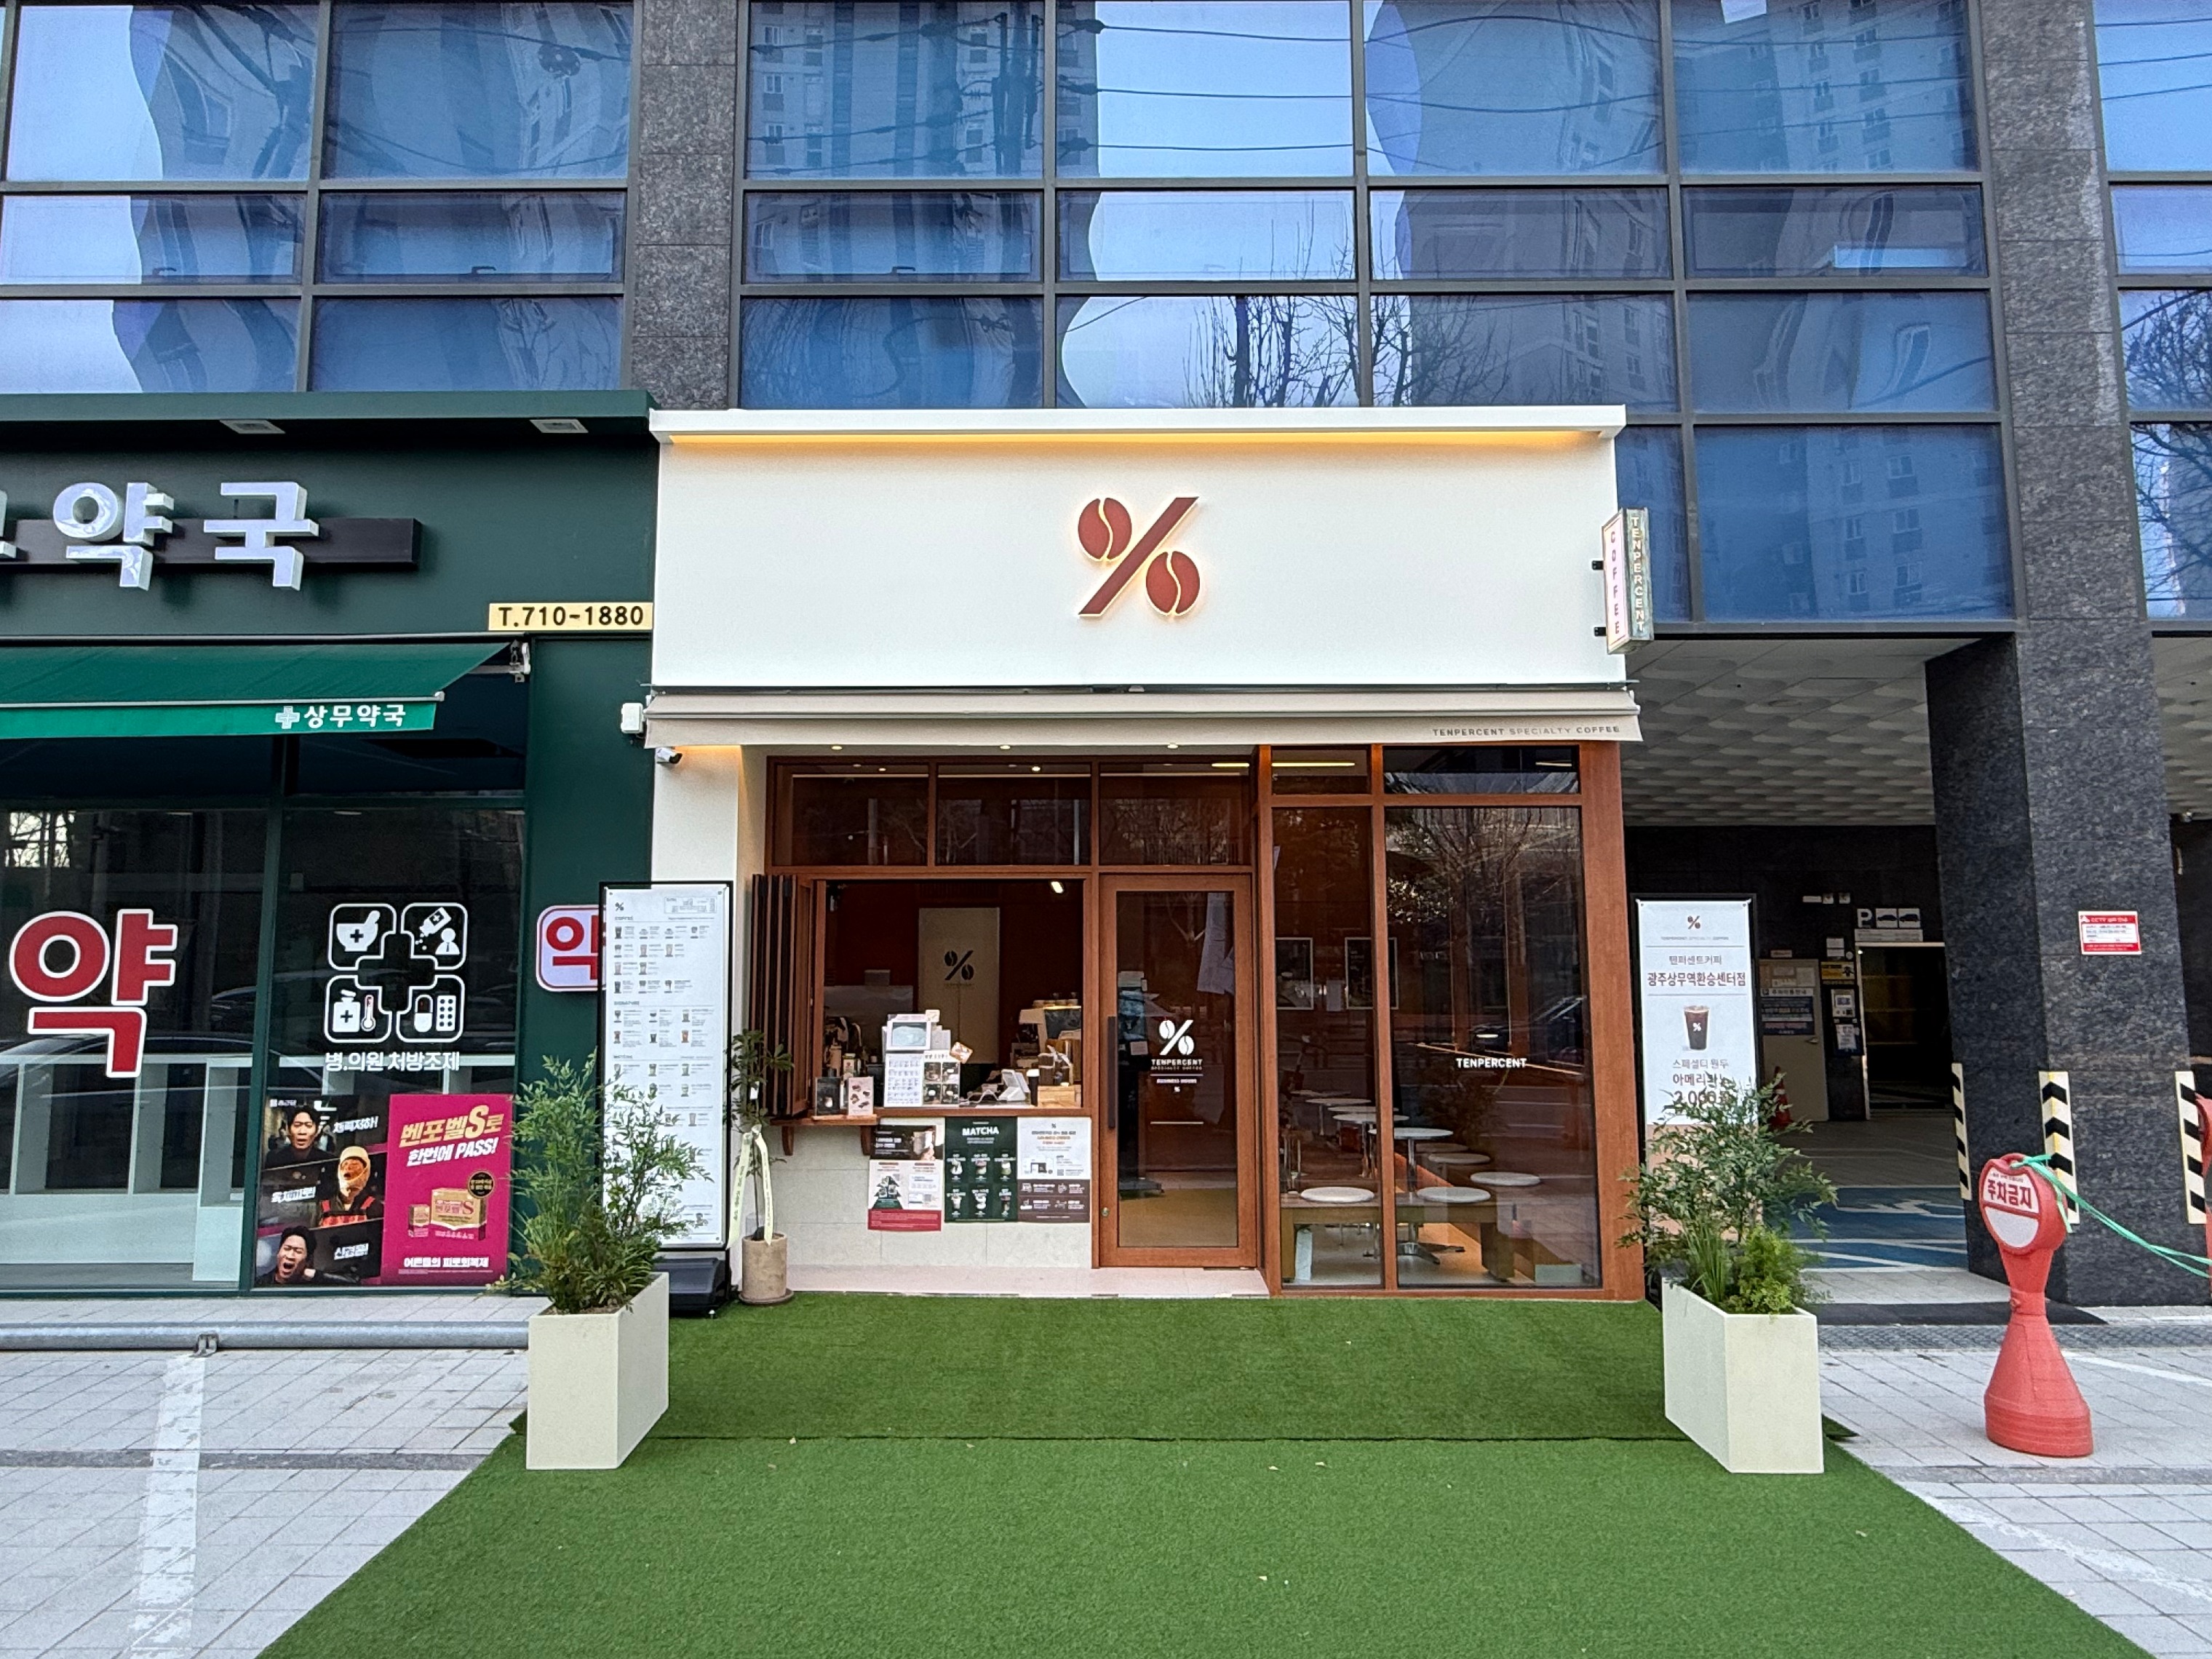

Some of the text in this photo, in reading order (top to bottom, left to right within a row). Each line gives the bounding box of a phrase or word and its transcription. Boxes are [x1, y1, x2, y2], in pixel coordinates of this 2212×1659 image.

[0, 482, 319, 592] 약국
[1610, 531, 1620, 634] COFFEE
[1631, 517, 1645, 633] TENPERCENT
[498, 605, 644, 627] T.710-1880
[304, 704, 406, 728] 상무약국
[1433, 728, 1504, 736] TENPERCENT
[1509, 727, 1572, 735] SPECIALTY
[1647, 971, 1746, 987] 광주상무역환승센터점
[9, 909, 178, 1078] 약
[325, 1051, 460, 1072] 병.의원 처방조제
[1456, 1057, 1527, 1069] TENPERCENT
[1711, 1058, 1730, 1069] 원두
[399, 1105, 504, 1148] 벤포벨S로
[962, 1126, 1000, 1136] MATCHA
[406, 1137, 499, 1167] 한번에 PASS!
[1987, 1179, 2032, 1209] 주차금지
